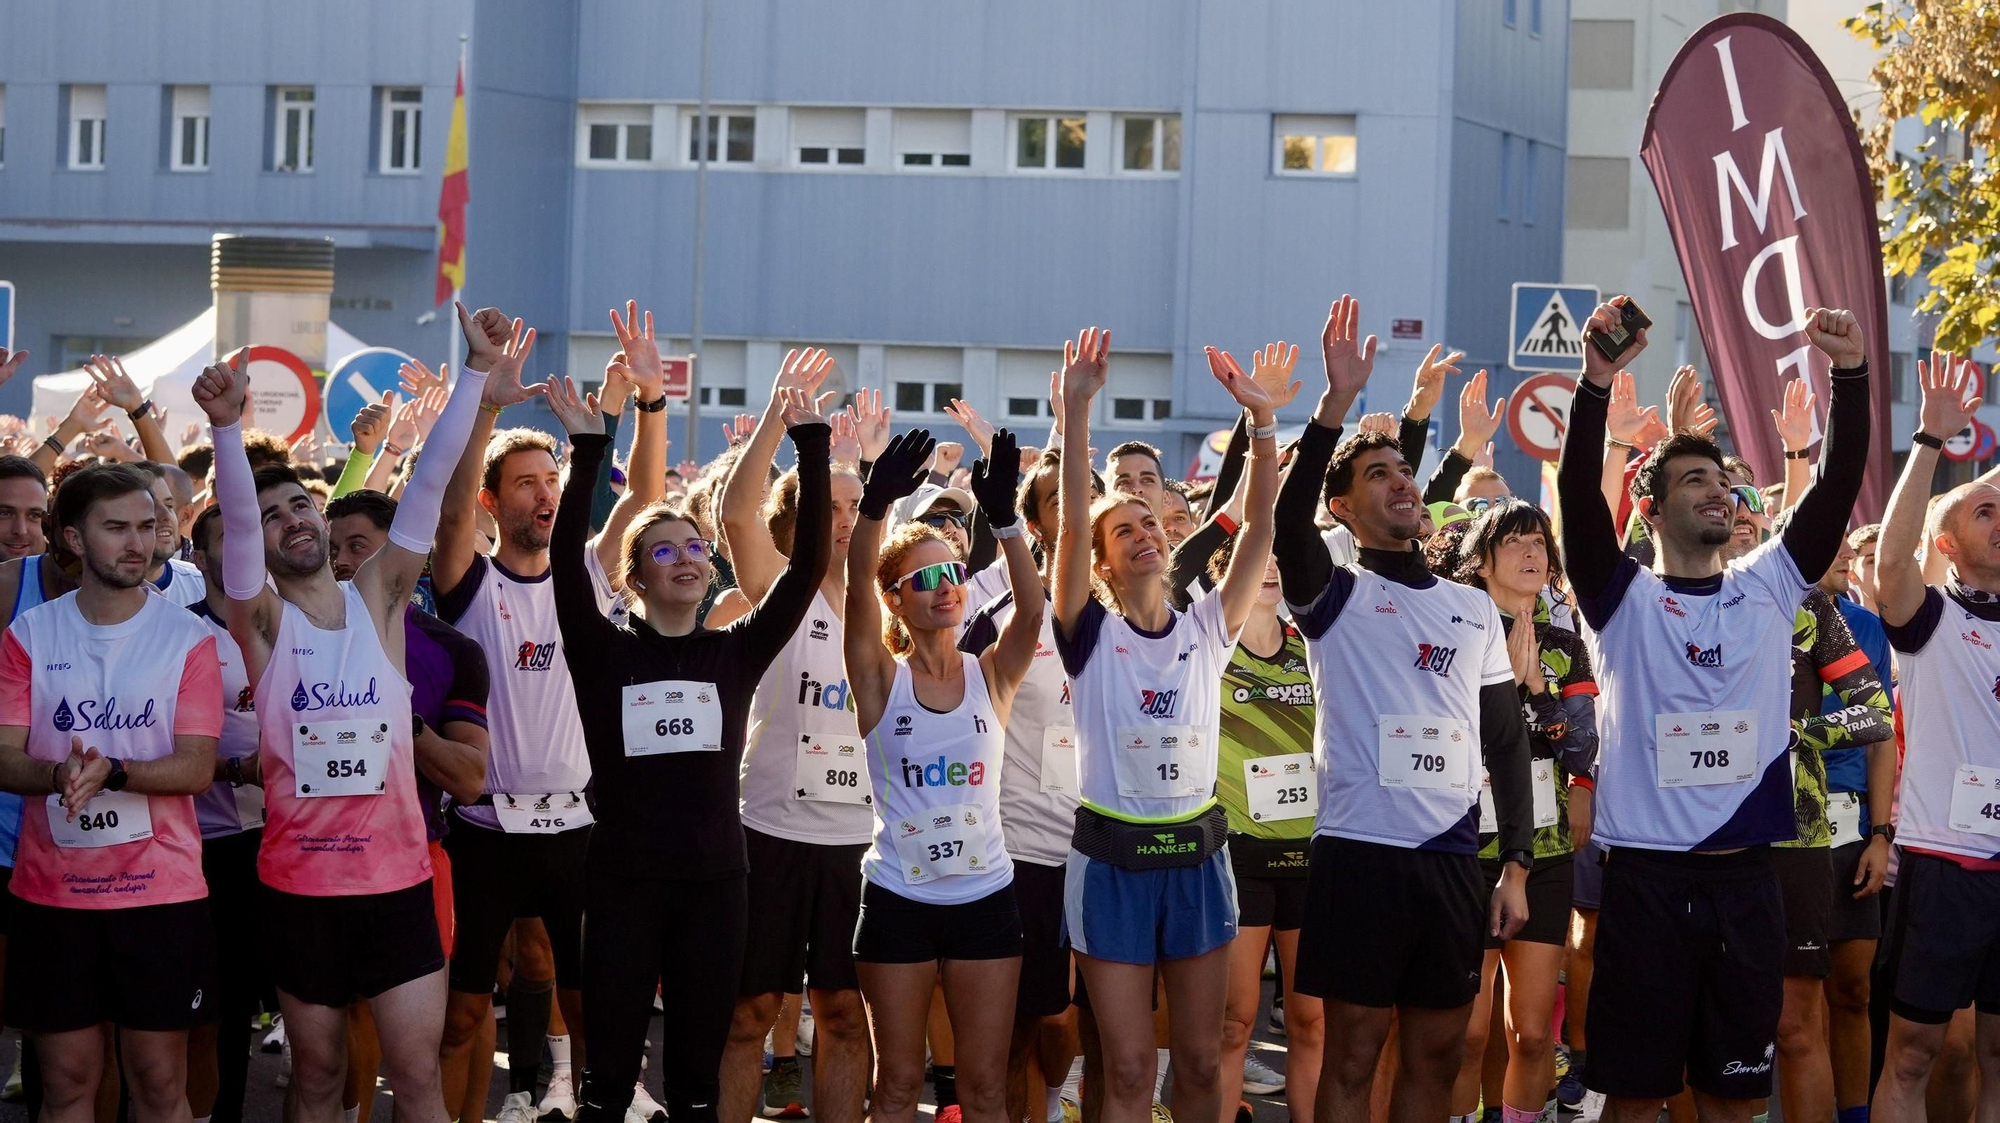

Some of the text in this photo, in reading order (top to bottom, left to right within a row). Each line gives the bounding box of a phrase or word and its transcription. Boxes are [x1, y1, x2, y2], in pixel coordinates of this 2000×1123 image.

[307, 676, 381, 711] Salud
[1288, 696, 1314, 706] TRAIL
[73, 696, 157, 732] Salud
[655, 717, 695, 737] 668
[1844, 716, 1878, 734] TRAIL
[326, 758, 367, 778] 854
[1411, 753, 1446, 773] 709
[1690, 749, 1730, 769] 708
[825, 769, 858, 788] 808
[901, 755, 986, 788] indea
[1156, 763, 1180, 781] 15
[1276, 786, 1308, 805] 253
[79, 810, 119, 831] 840
[530, 817, 566, 829] 476
[927, 839, 964, 862] 337
[1136, 841, 1198, 855] HANKER
[119, 868, 156, 882] Personal
